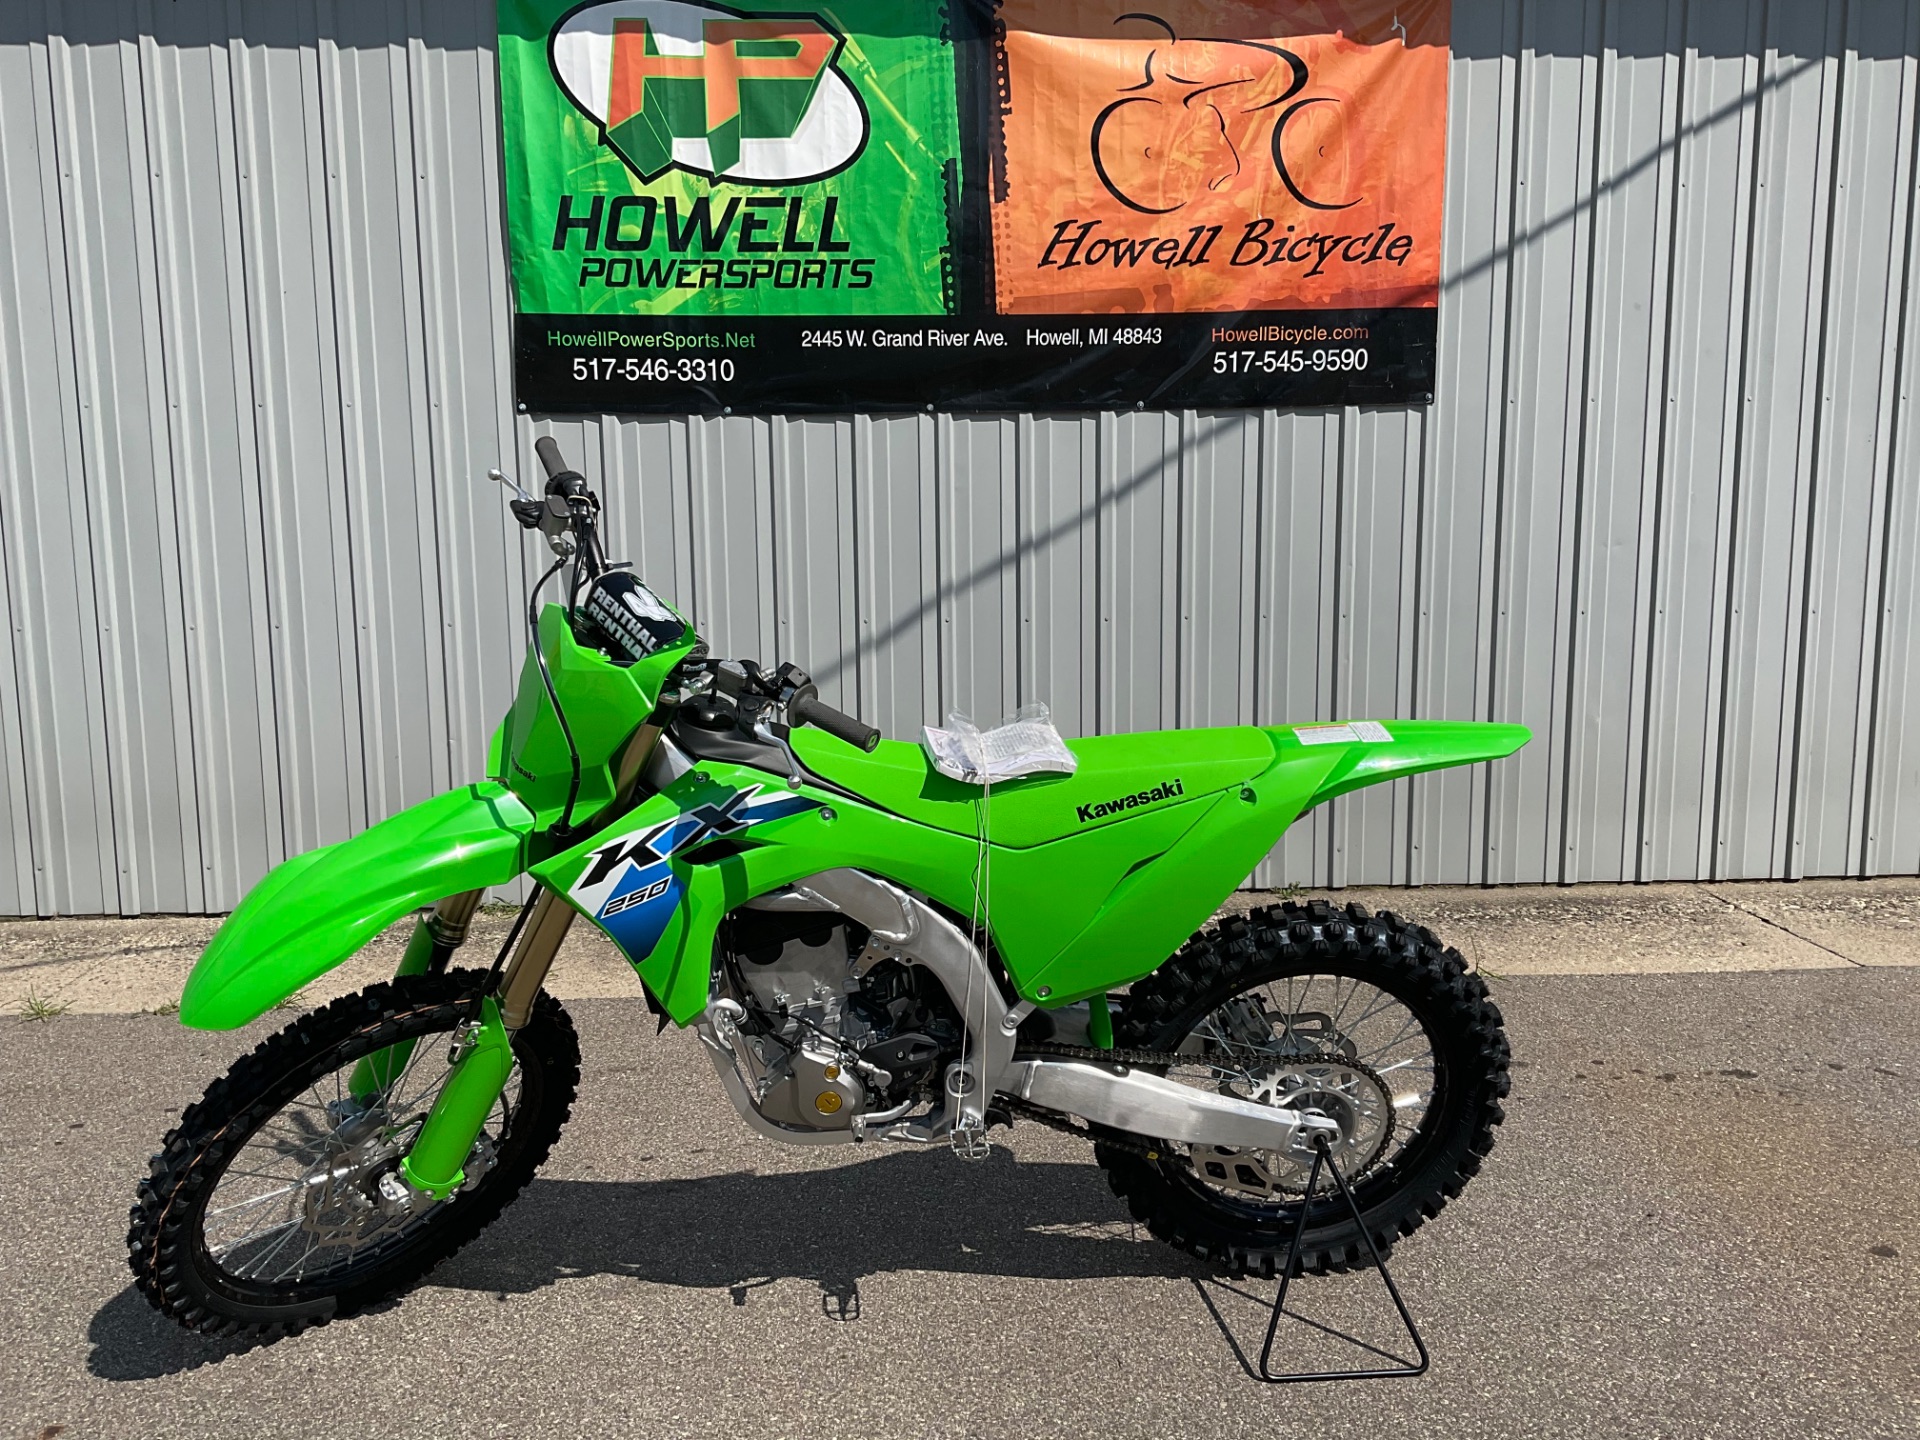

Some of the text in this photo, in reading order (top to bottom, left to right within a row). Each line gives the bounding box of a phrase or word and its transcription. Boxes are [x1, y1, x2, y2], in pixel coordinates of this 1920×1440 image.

[606, 18, 840, 177] HP
[552, 195, 851, 253] HOWELL
[1037, 218, 1413, 278] Howell Bicycle
[579, 257, 876, 289] POWERSPORTS
[547, 330, 756, 351] HowellPowerSports.Net
[801, 327, 1162, 348] 2445 W. Grand River Ave. Howell, MI 48843
[1211, 326, 1369, 345] HowellBicycle.com
[572, 358, 735, 381] 517-546-3310
[1213, 348, 1369, 374] 517-545-9590
[592, 586, 658, 654] RENTHAL
[1076, 778, 1184, 823] Kawasaki
[577, 783, 764, 890] KX
[600, 873, 673, 919] 250
